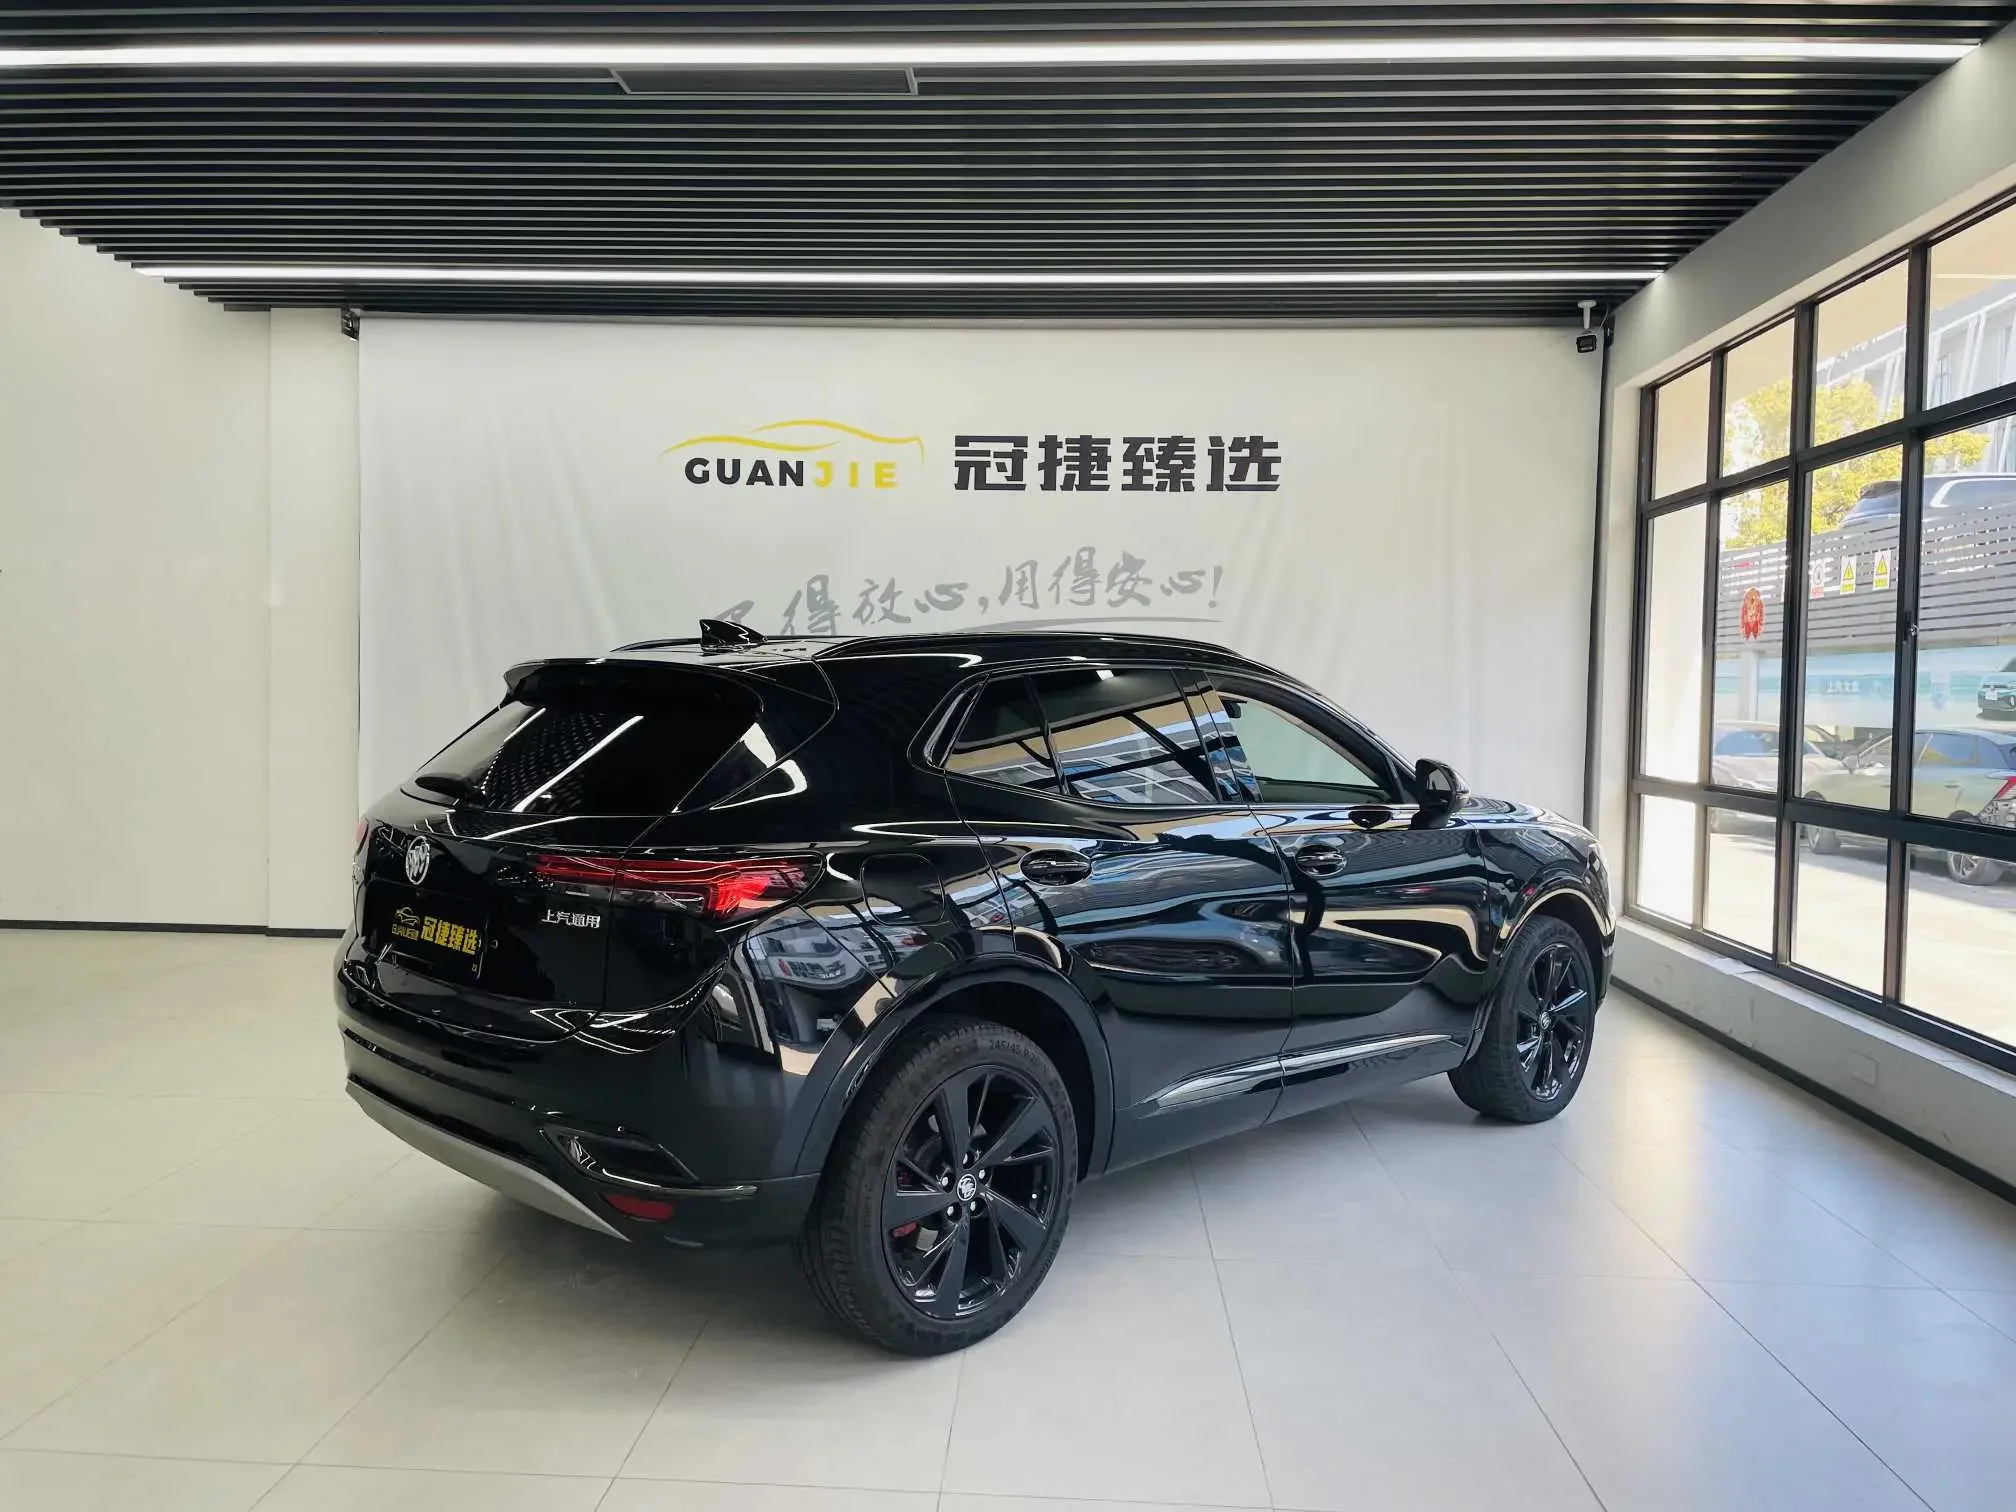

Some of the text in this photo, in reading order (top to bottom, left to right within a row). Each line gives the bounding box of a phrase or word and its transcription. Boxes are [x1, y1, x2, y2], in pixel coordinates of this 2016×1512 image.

[685, 457, 898, 489] GUANJIE
[954, 435, 1282, 492] 冠捷臻选
[421, 916, 478, 955] 冠捷臻选
[542, 909, 601, 928] 上汽通用
